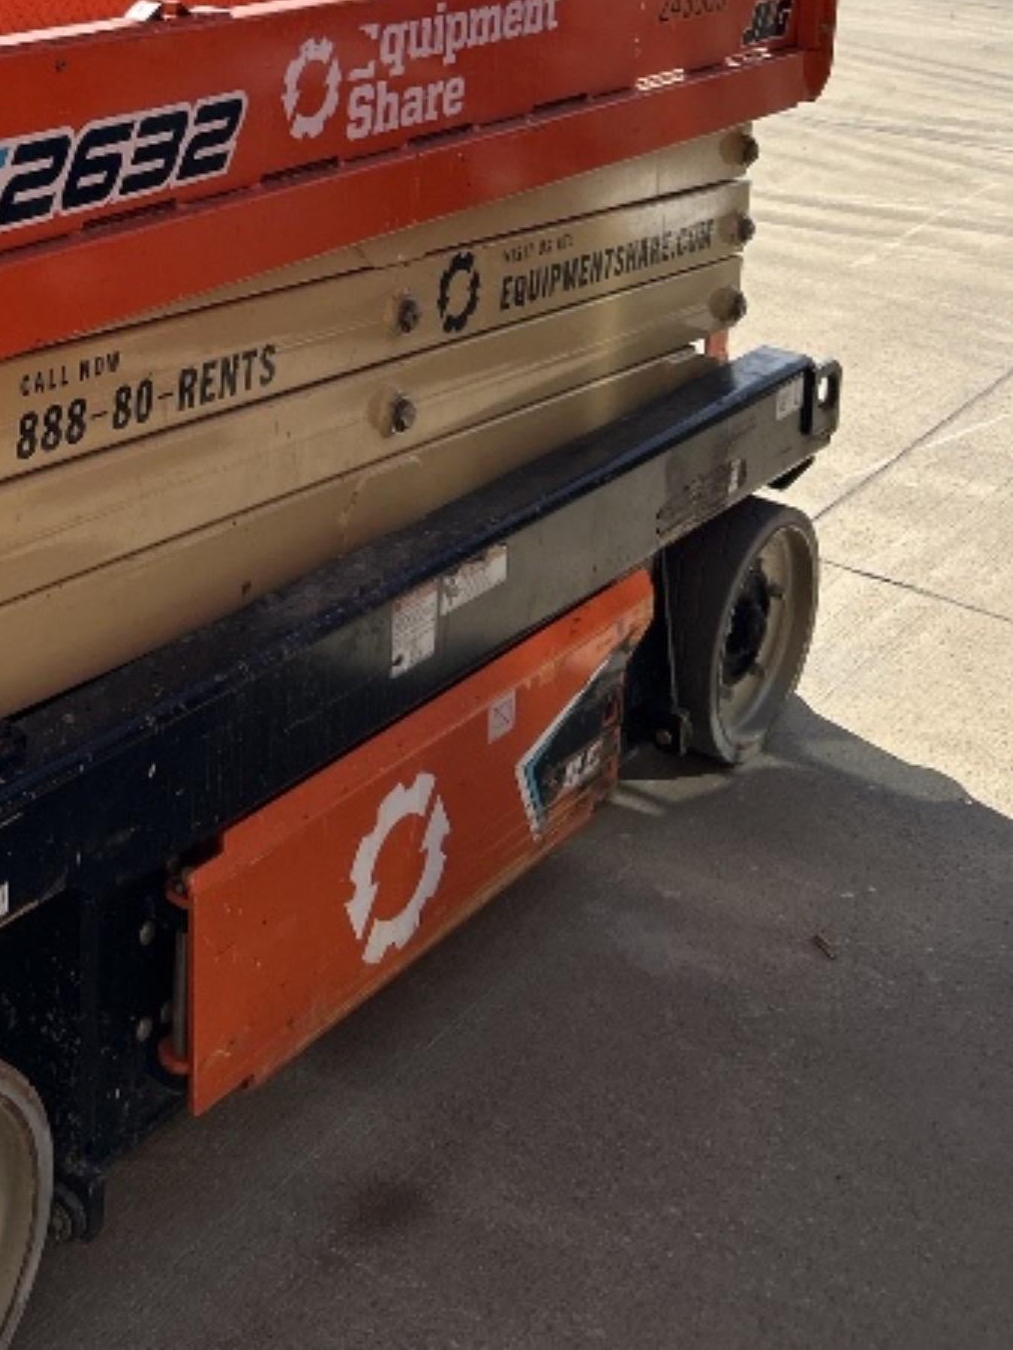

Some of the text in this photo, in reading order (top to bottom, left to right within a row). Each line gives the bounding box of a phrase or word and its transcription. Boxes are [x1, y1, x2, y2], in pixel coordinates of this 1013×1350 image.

[345, 76, 466, 141] Share
[17, 343, 277, 460] 888-80-RENTS
[20, 365, 69, 397] CALL
